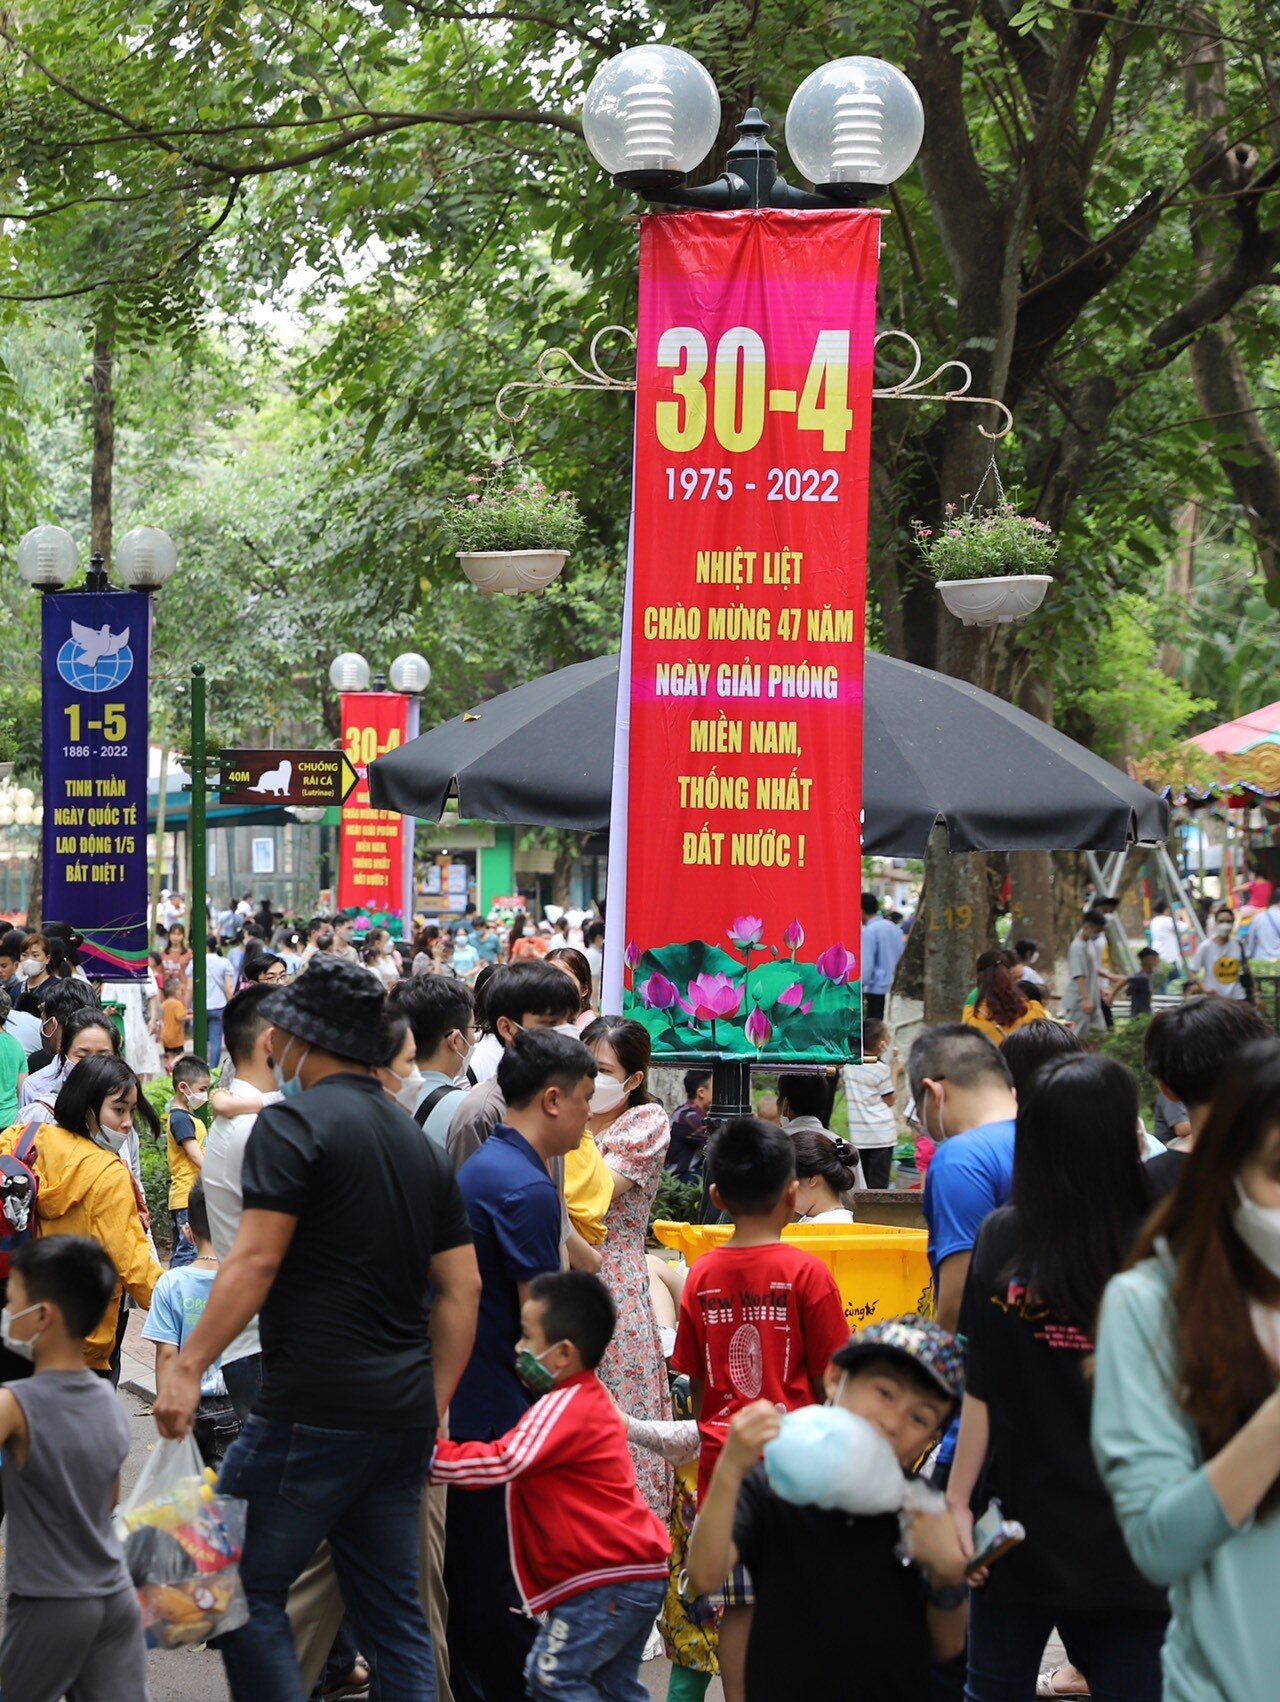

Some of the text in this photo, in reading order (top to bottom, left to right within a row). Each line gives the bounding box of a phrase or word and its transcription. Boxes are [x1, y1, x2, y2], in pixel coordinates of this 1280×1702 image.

[656, 326, 853, 453] 30-4
[666, 467, 733, 501] 1975
[767, 468, 839, 502] 2022
[696, 545, 803, 591] NHIỆT LIỆT
[644, 602, 854, 642] CHÀO MỪNG 47 NĂM
[655, 656, 838, 699] NGÀY GIẢI PHÓNG
[64, 704, 127, 741] 1-5
[690, 710, 802, 757] MIỀN NAM,
[63, 746, 90, 757] 1886
[100, 746, 128, 757] 2022
[65, 773, 126, 797] TINH THẦN
[228, 771, 250, 782] 40M
[303, 775, 333, 786] RÁI CÁ
[678, 765, 812, 811] THỐNG NHẤT
[54, 802, 137, 827] NGÀY QUỐC TẾ
[56, 834, 135, 857] LAO ĐỘNG 1/5
[682, 822, 725, 866] ĐẤT
[731, 828, 791, 867] NƯỚC
[66, 859, 88, 882] BẤT
[91, 862, 116, 885] DIỆT
